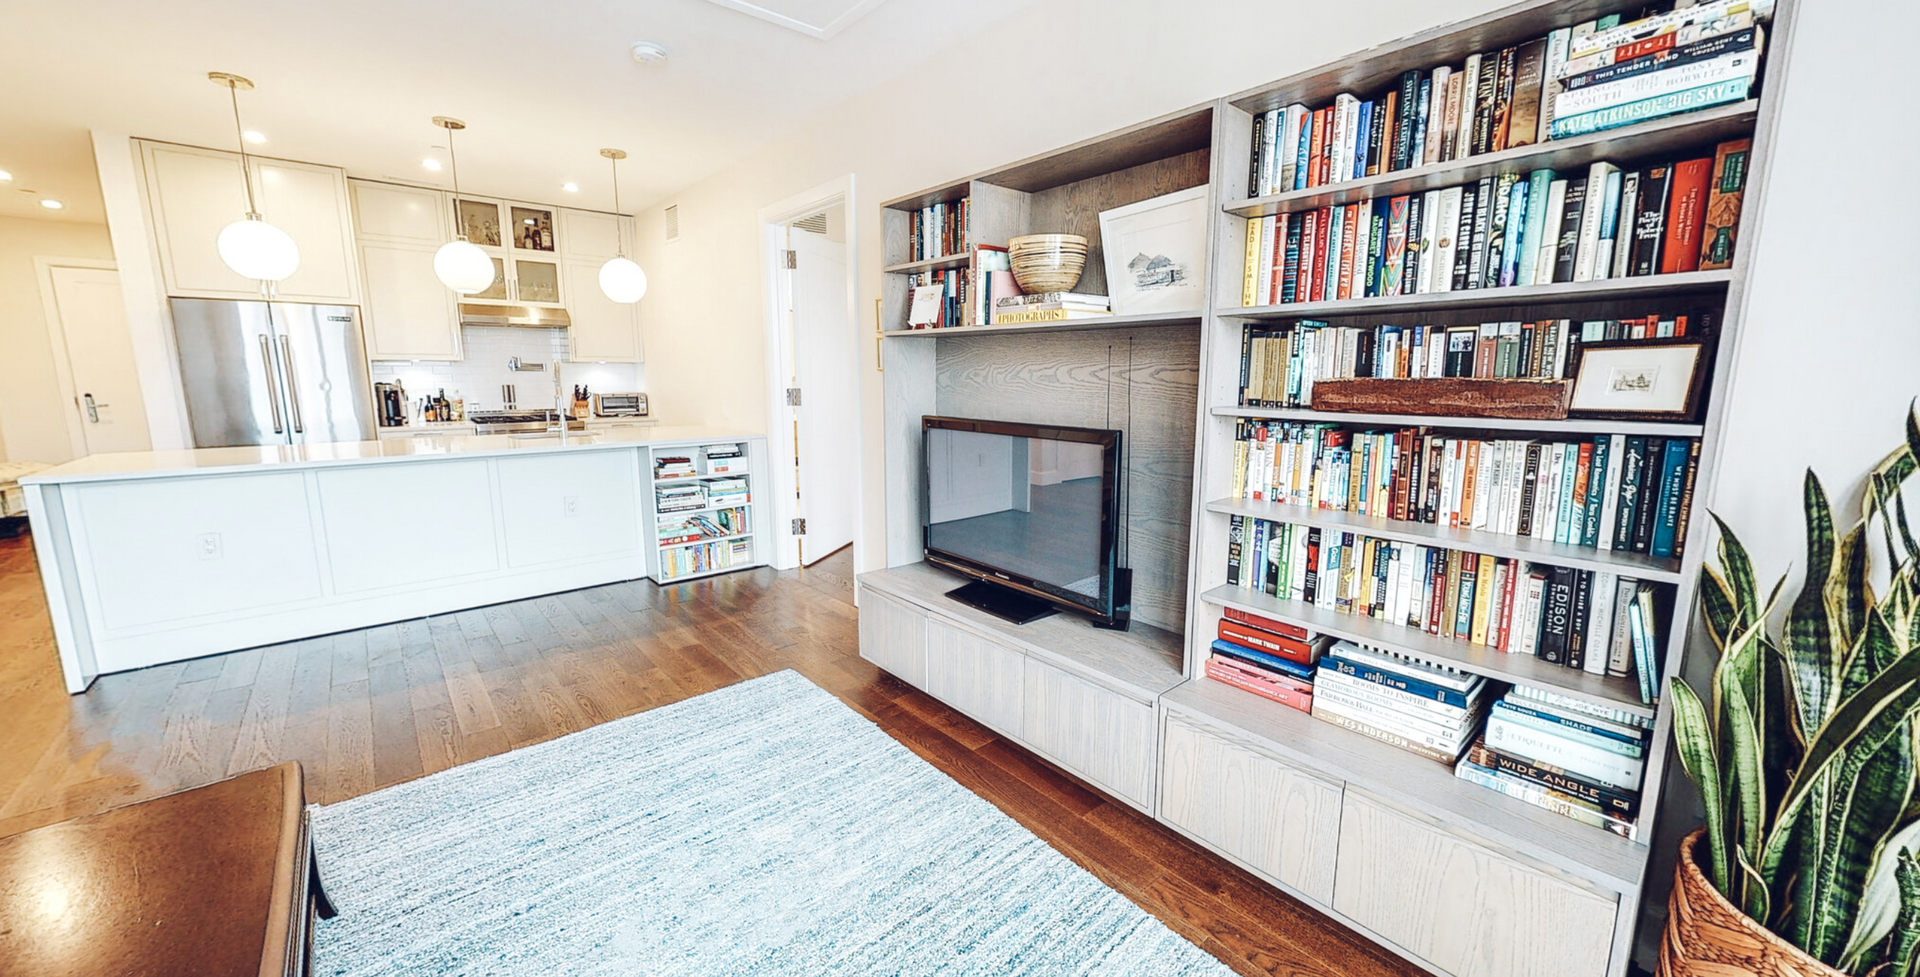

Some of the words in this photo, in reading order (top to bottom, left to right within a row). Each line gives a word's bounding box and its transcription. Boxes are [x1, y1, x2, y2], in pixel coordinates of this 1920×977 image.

[1480, 61, 1495, 79] AMY
[1597, 71, 1613, 79] THIS
[1618, 61, 1650, 74] TENDER
[1655, 53, 1678, 65] LAND
[1667, 68, 1725, 87] HORWITZ
[1403, 81, 1412, 116] SVETLANA
[1478, 78, 1493, 98] TAN
[1574, 91, 1622, 108] SOUTH
[1669, 92, 1690, 109] BIG
[1698, 84, 1725, 102] SKY
[1447, 102, 1455, 125] MOORE
[1561, 116, 1587, 134] KATE
[1595, 98, 1660, 127] ATKINSON
[1370, 107, 1381, 147] Mockingbird
[1398, 119, 1408, 160] ALEXIEVICH
[1462, 194, 1475, 212] JOHN
[1494, 179, 1512, 224] IDAHO
[1585, 207, 1594, 236] AMERICA
[1342, 221, 1354, 251] LEAVERS
[1369, 217, 1378, 254] MARGARET
[1302, 236, 1310, 270] SLAUGHTER
[1357, 235, 1367, 274] Educated
[1341, 261, 1350, 275] LISA
[1366, 258, 1375, 286] ATWOOD
[1245, 267, 1253, 300] SMITH
[1340, 279, 1348, 287] KO
[1265, 441, 1274, 467] SPAIN
[1595, 456, 1603, 466] Last
[1597, 446, 1605, 454] The
[1323, 459, 1331, 482] Panama
[1492, 470, 1500, 486] ROBBINS
[1624, 449, 1641, 485] American
[1674, 467, 1682, 475] WE
[1512, 472, 1521, 488] ROBBINS
[1591, 469, 1601, 495] Romantics
[1671, 479, 1680, 494] MUST
[1620, 484, 1637, 506] Pop
[1589, 505, 1597, 515] Tara
[1667, 508, 1676, 526] BRAVE
[1586, 518, 1595, 538] Conklin
[1552, 586, 1568, 634] EDISON
[1595, 610, 1604, 637] MICHELLE
[1249, 637, 1262, 645] MARK
[1264, 641, 1279, 650] TWAIN
[1592, 641, 1600, 661] OBAMA
[1354, 679, 1380, 693] ROOMS
[1383, 688, 1393, 697] TO
[1397, 692, 1428, 707] INSPIRE
[1518, 708, 1537, 716] SOUZA
[1335, 716, 1356, 730] WES
[1359, 724, 1408, 748] ANDERSON
[1561, 719, 1592, 732] SHADE
[1511, 733, 1564, 755] ETIQUETTE
[1499, 759, 1538, 777] WIDE
[1543, 773, 1600, 798] ANGLE
